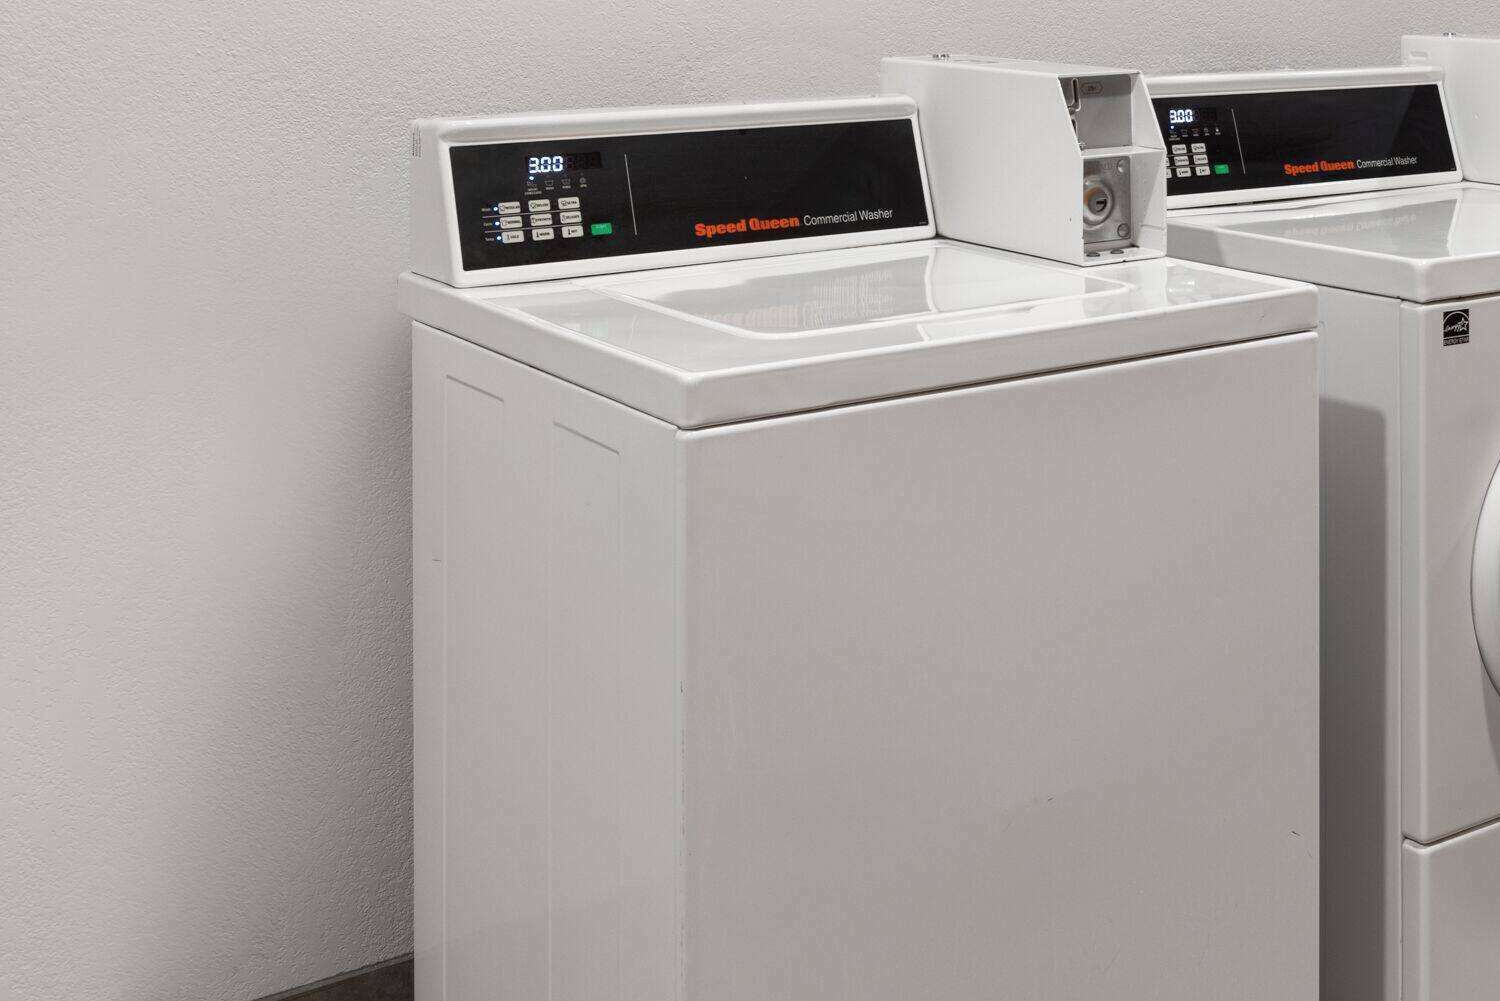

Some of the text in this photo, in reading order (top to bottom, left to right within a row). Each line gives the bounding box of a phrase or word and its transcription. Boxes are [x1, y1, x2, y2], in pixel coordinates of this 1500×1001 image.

[528, 155, 564, 174] 3.00
[1284, 156, 1418, 176] Speed Queen Commercial Washer
[695, 208, 894, 238] Speed Queen Commercial Washer
